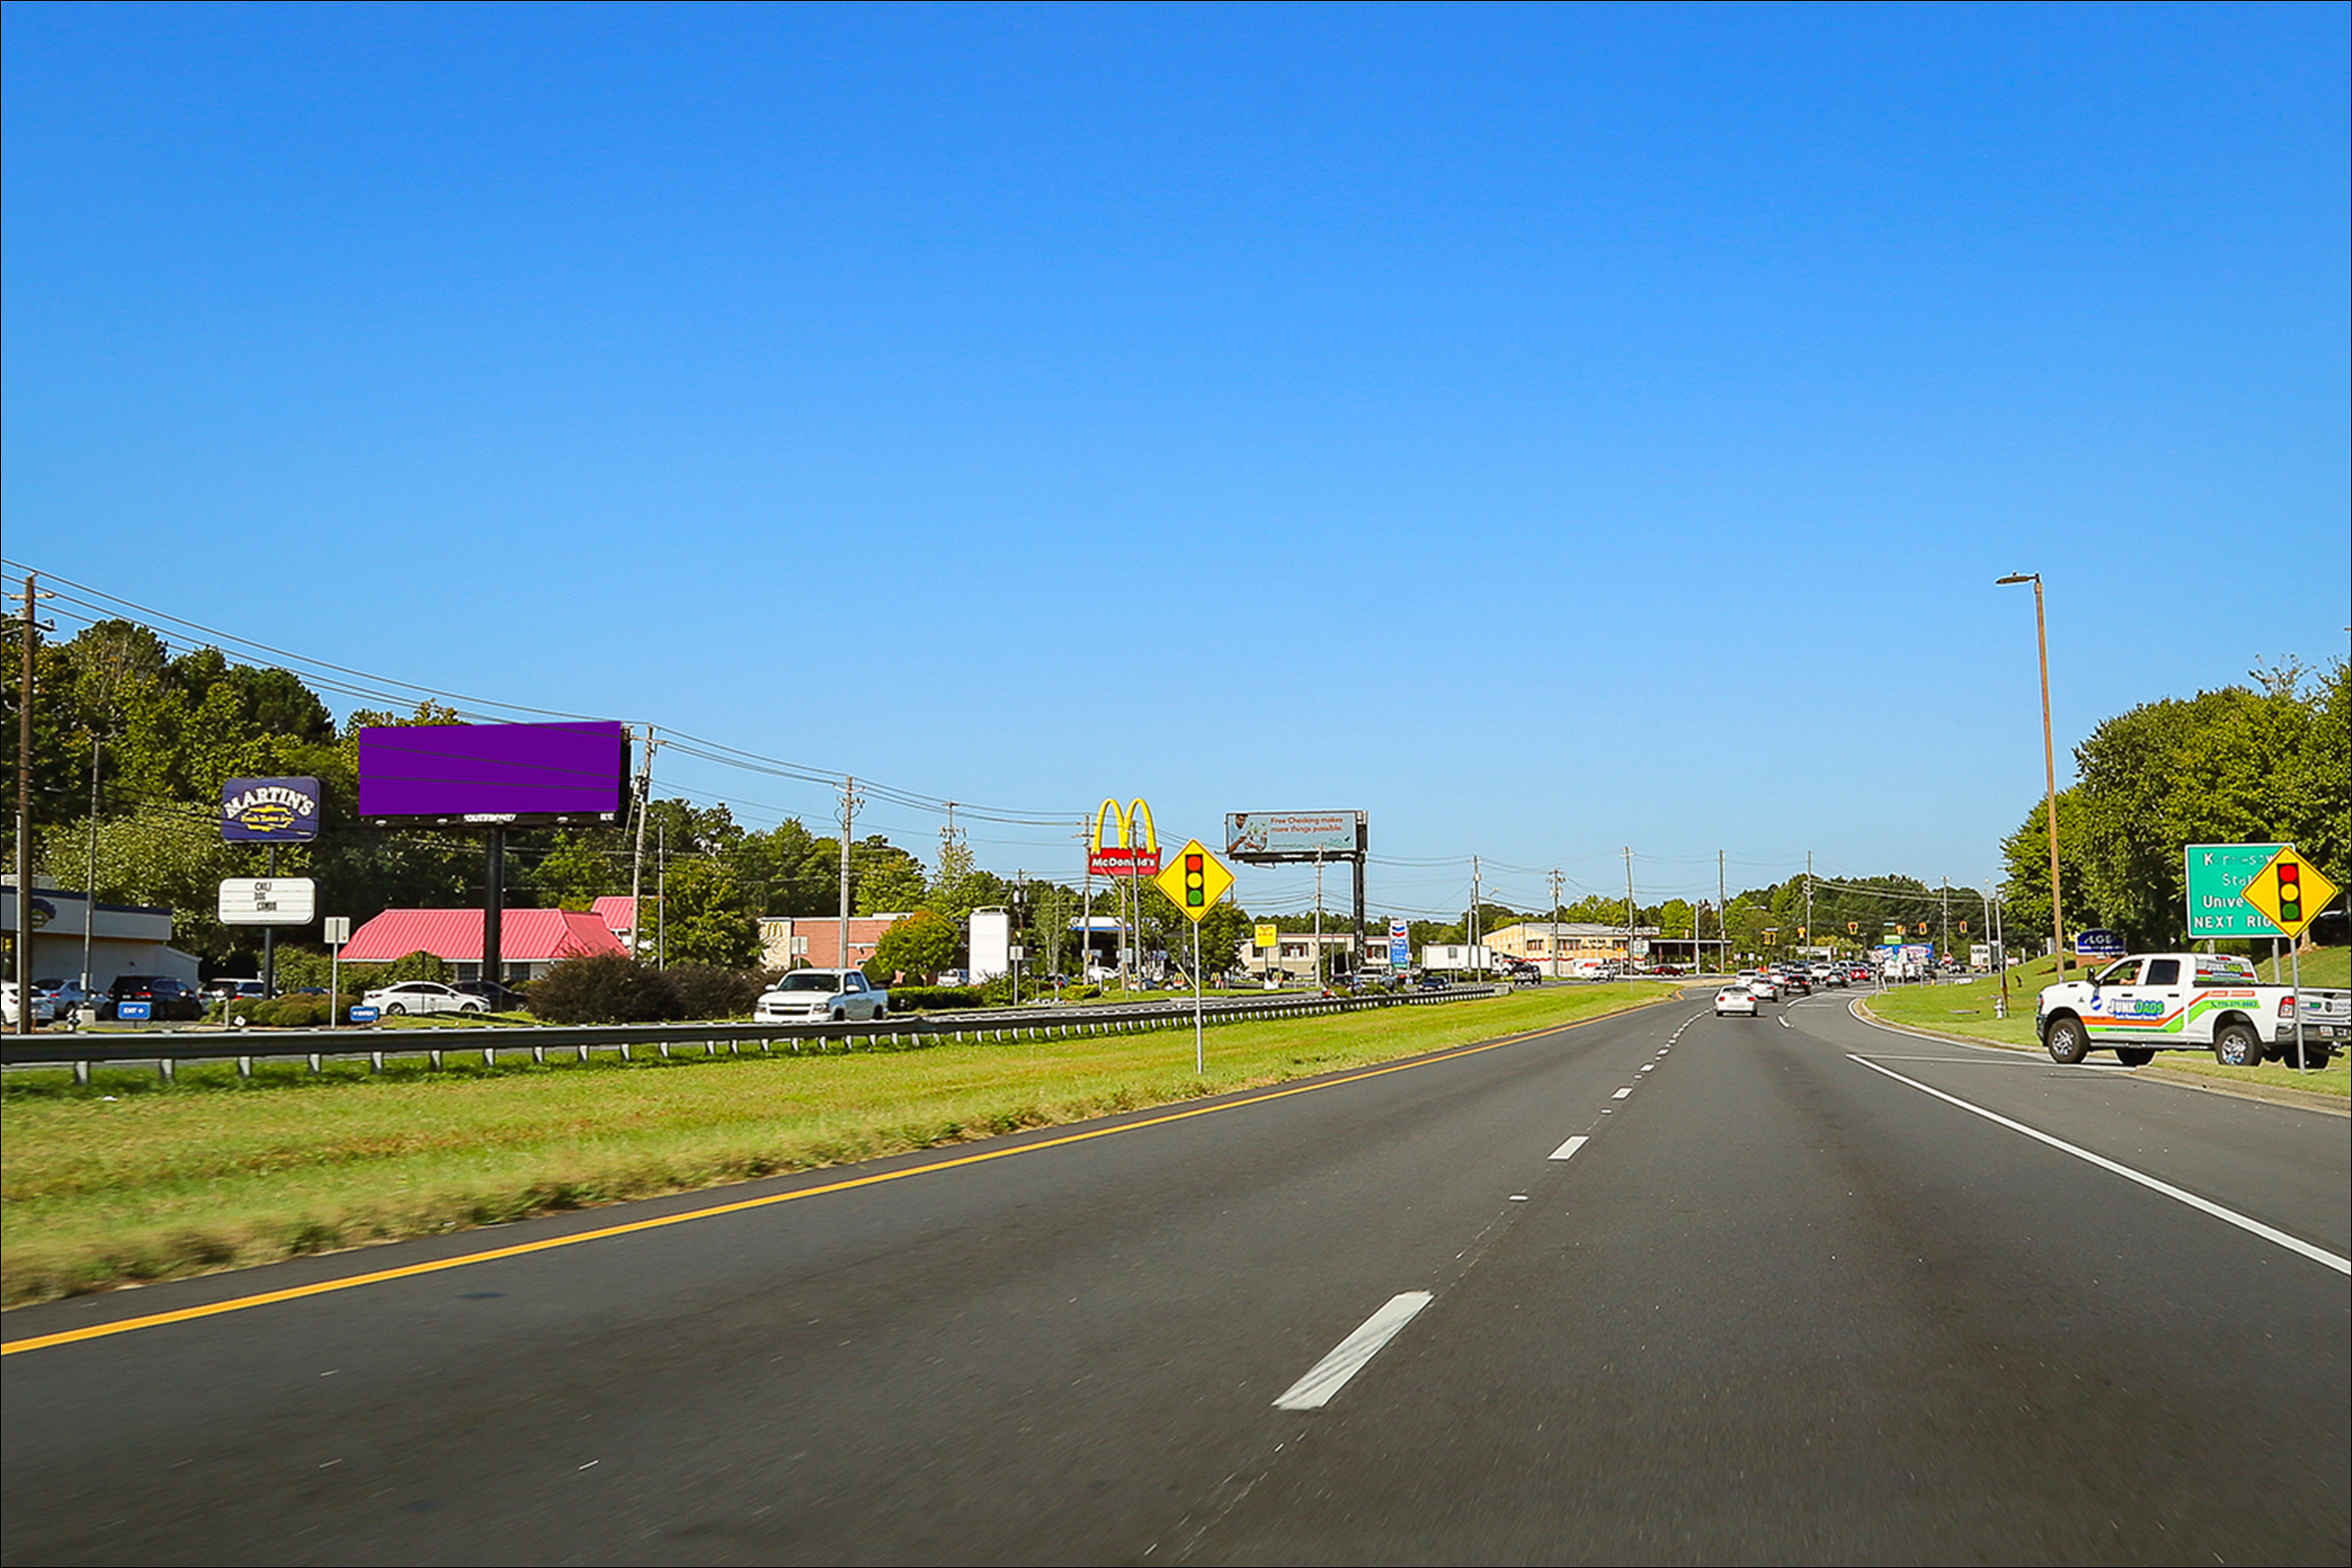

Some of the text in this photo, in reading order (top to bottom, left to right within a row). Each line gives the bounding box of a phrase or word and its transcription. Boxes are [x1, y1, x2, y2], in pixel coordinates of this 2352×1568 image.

[223, 786, 316, 819] MARTIN'S
[1288, 816, 1319, 825] Checking
[1092, 857, 1155, 867] McDonld's
[2222, 873, 2253, 887] Stat
[2202, 895, 2244, 908] Unive
[2193, 916, 2274, 929] NEXT RIG
